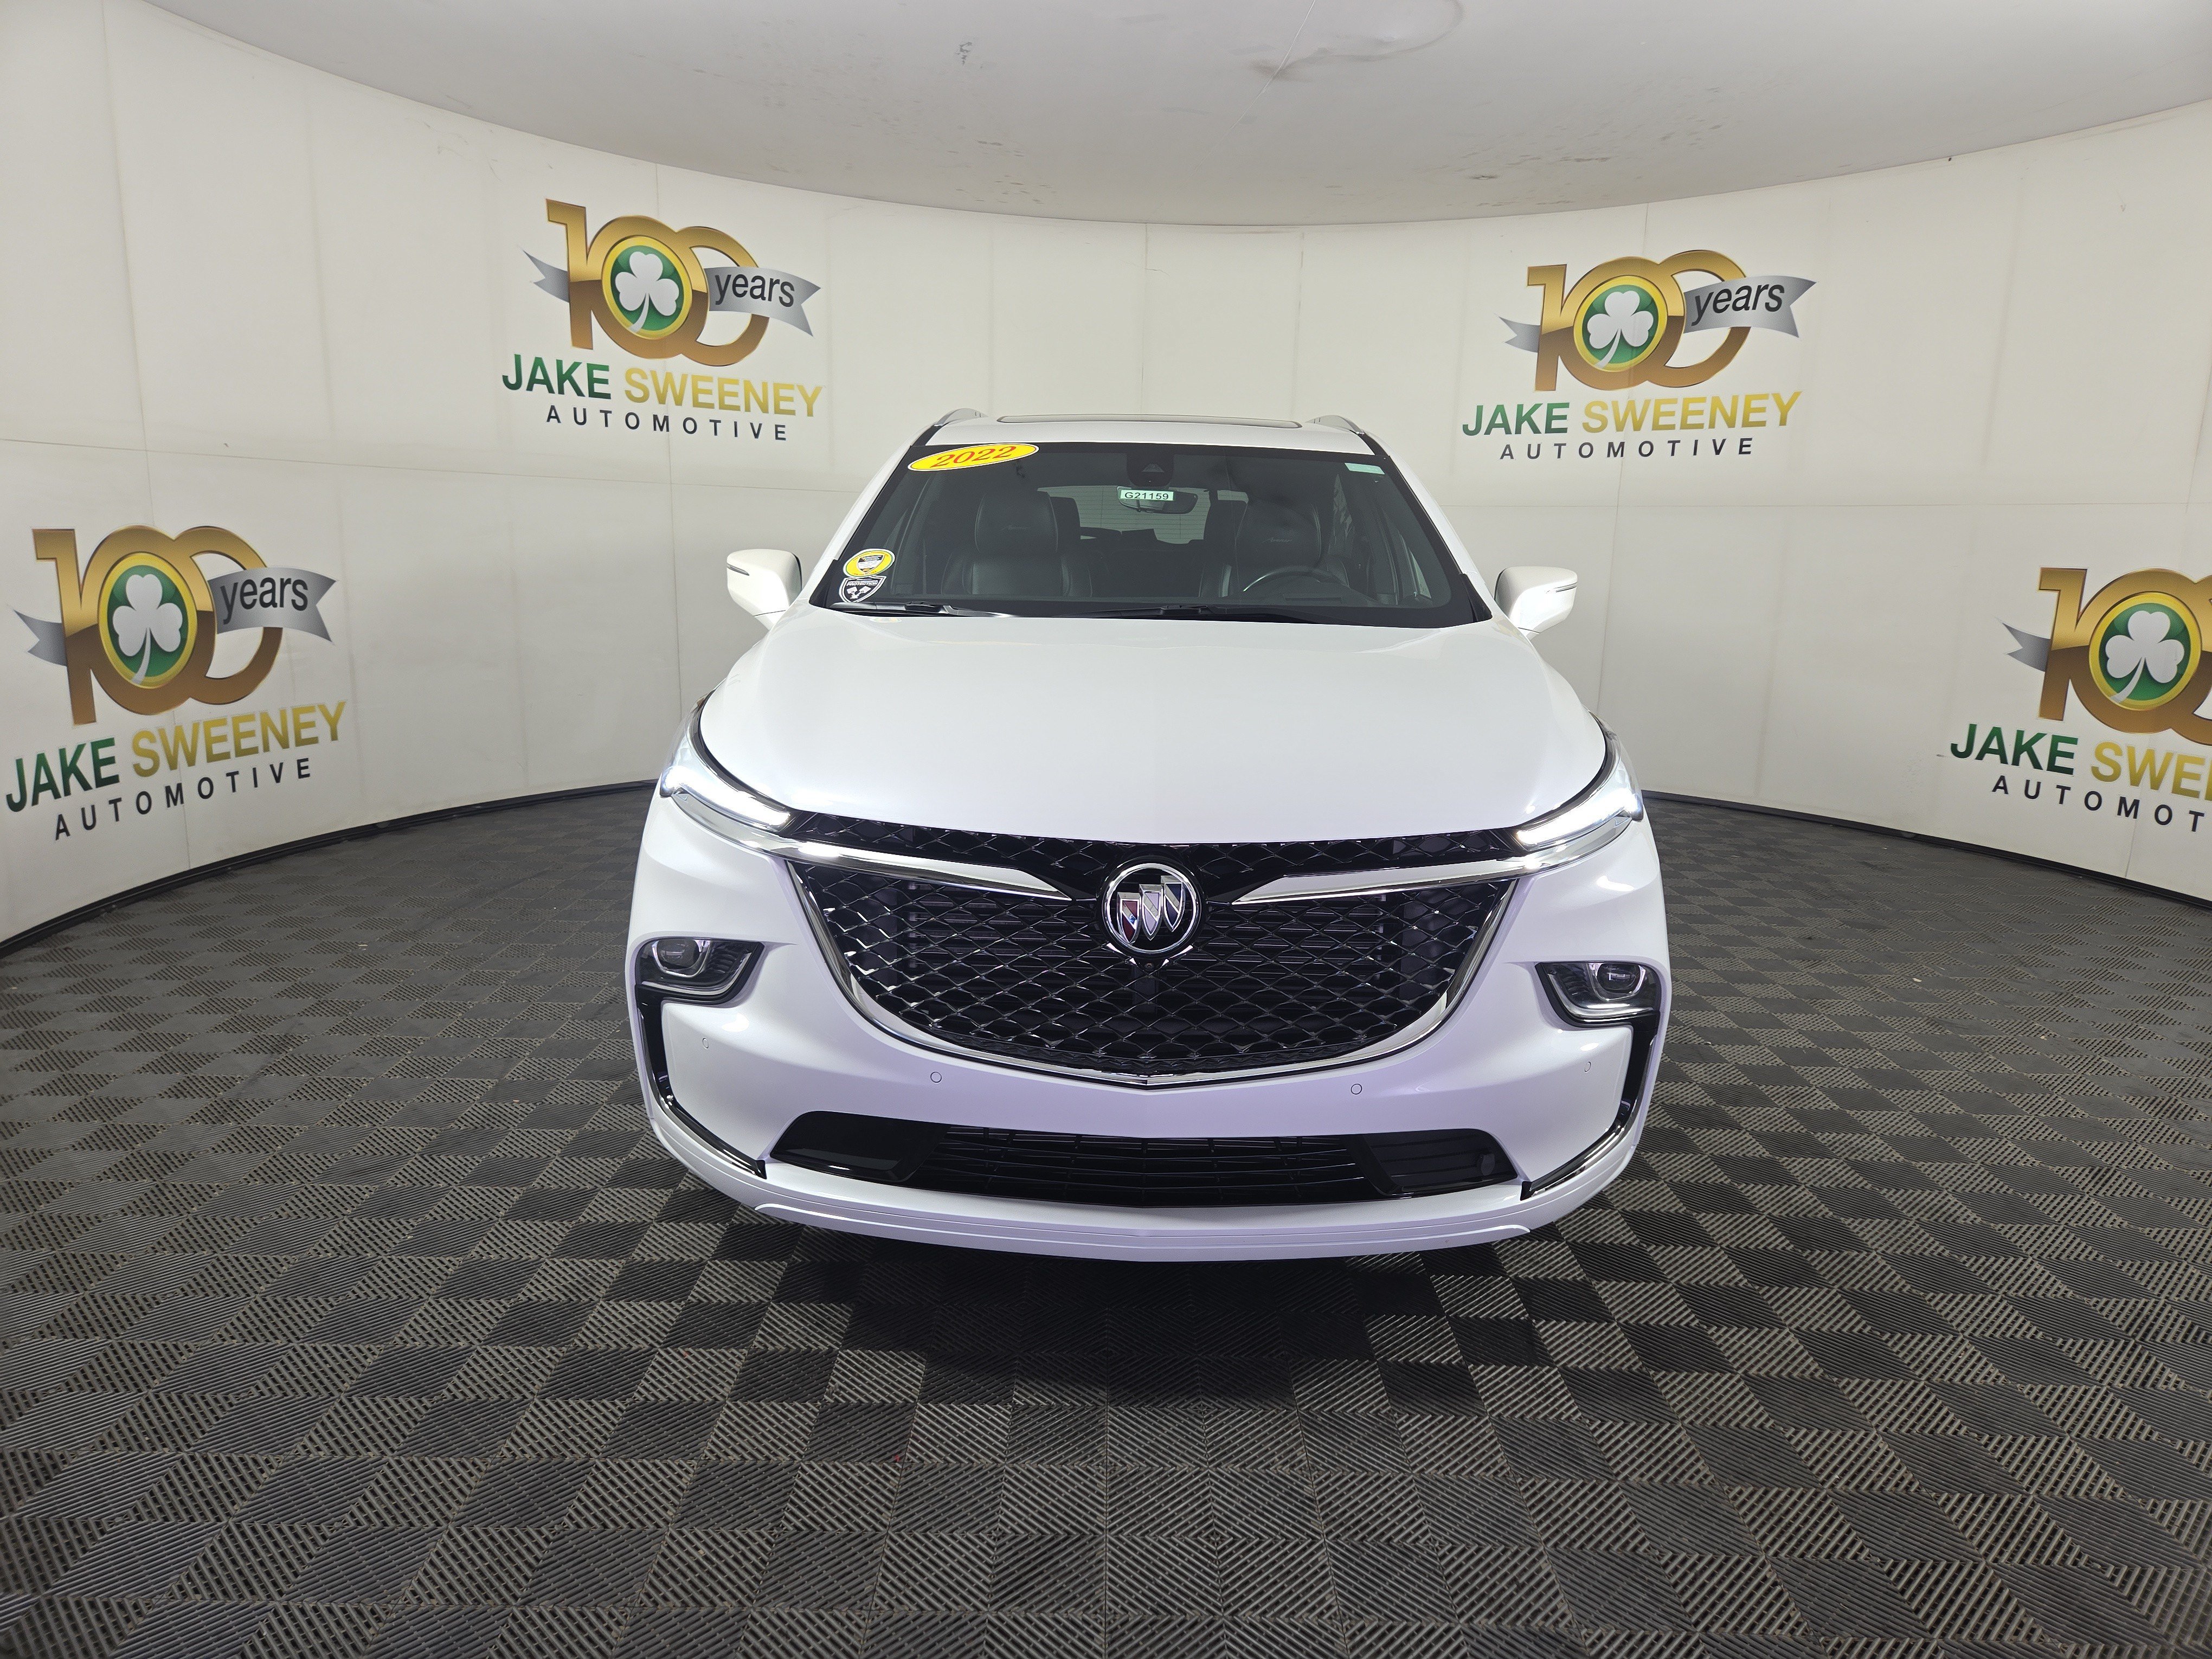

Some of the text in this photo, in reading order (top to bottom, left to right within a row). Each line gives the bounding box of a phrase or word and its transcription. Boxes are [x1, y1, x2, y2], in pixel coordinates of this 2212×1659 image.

[545, 198, 795, 366] 100 years
[1526, 249, 1785, 391] 100 years
[502, 353, 823, 417] JAKE SWEENEY
[546, 405, 786, 441] AUTOMOTIVE
[1462, 391, 1802, 436] JAKE SWEENEY
[930, 446, 1017, 468] 2022
[1500, 438, 1753, 460] AUTOMOTIVE
[32, 525, 308, 725] 100 years
[2038, 567, 2212, 746] 10
[5, 701, 346, 812] JAKE SWEENEY
[1951, 723, 2212, 801] JAKE SWE
[55, 757, 311, 840] AUTOMOTIVE
[1992, 775, 2204, 832] AUTOMOT
